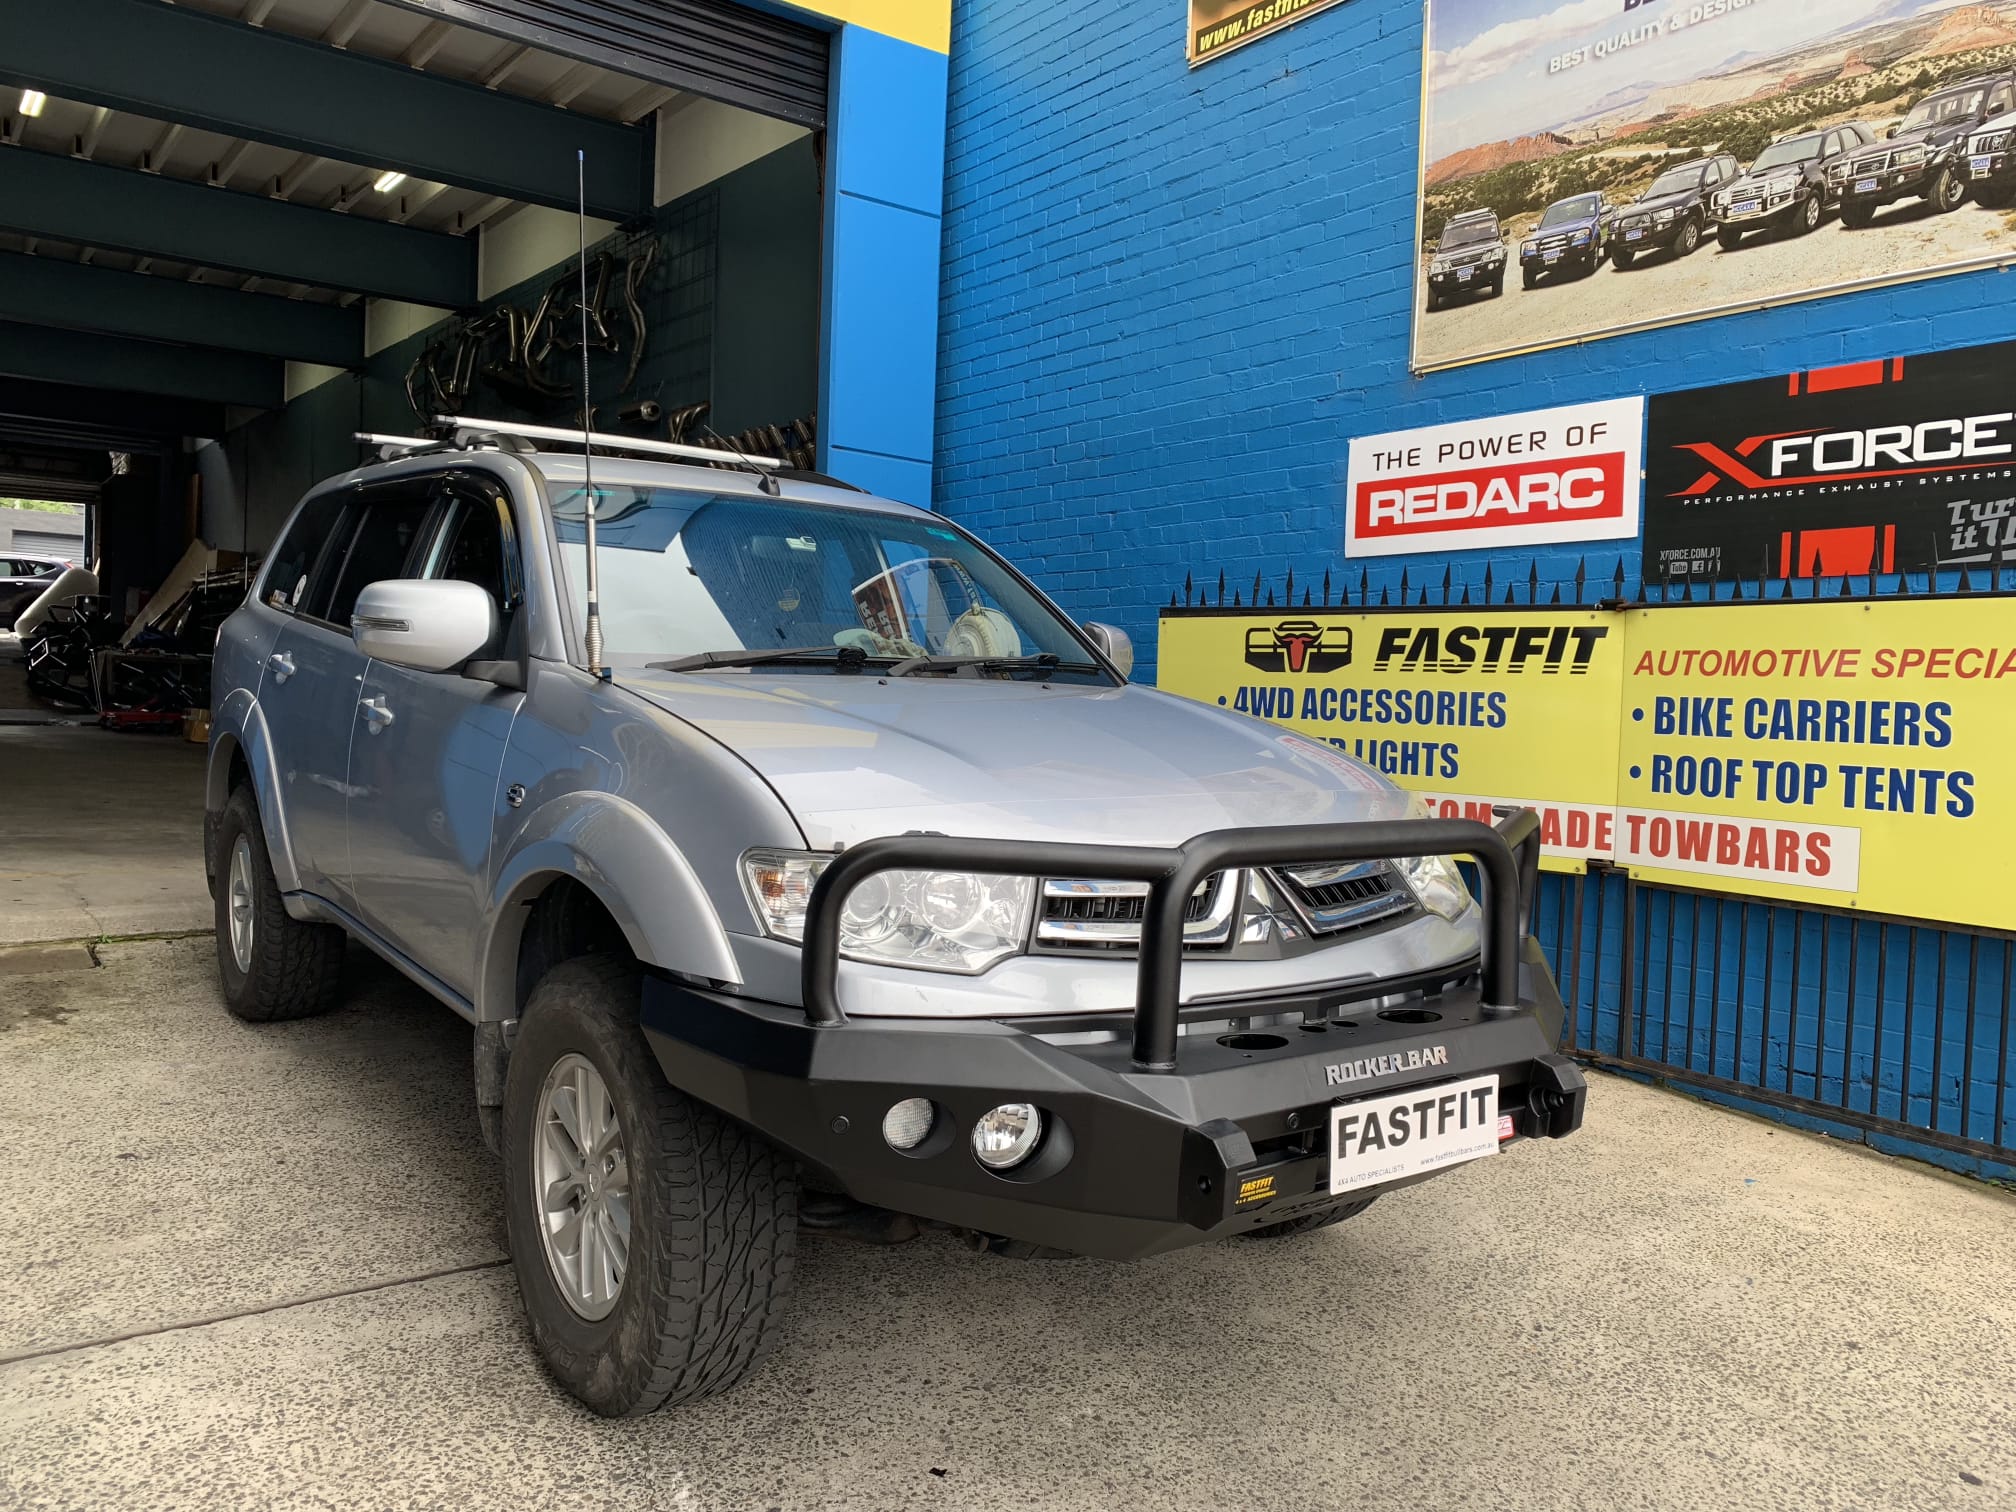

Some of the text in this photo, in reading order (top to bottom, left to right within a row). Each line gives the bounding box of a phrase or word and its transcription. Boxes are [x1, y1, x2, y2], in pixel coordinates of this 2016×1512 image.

[1550, 0, 1753, 73] BEST QUALITY & DESI
[1372, 422, 1608, 472] THE POWER OF
[1665, 412, 2013, 497] XFORCE
[1368, 466, 1605, 527] REDARC
[1684, 470, 2012, 505] PERFORMANCE EXHAUST SYSTEMS
[1373, 625, 1609, 675] FASTFIT
[1633, 649, 1862, 678] AUTOMOTIVE
[1233, 686, 1507, 728] 4WD ACCESSORIES
[1654, 696, 1952, 748] BIKE CARRIERS
[1651, 754, 1975, 818] ROOF TOP TENTS
[1529, 807, 1613, 851] ADE
[1626, 814, 1831, 877] TOWBARS
[1325, 1045, 1449, 1086] ROCKER BAR
[1338, 1086, 1493, 1160] FASTFIT
[1350, 1174, 1367, 1185] AUTO
[1367, 1164, 1405, 1180] SPECIALISTS
